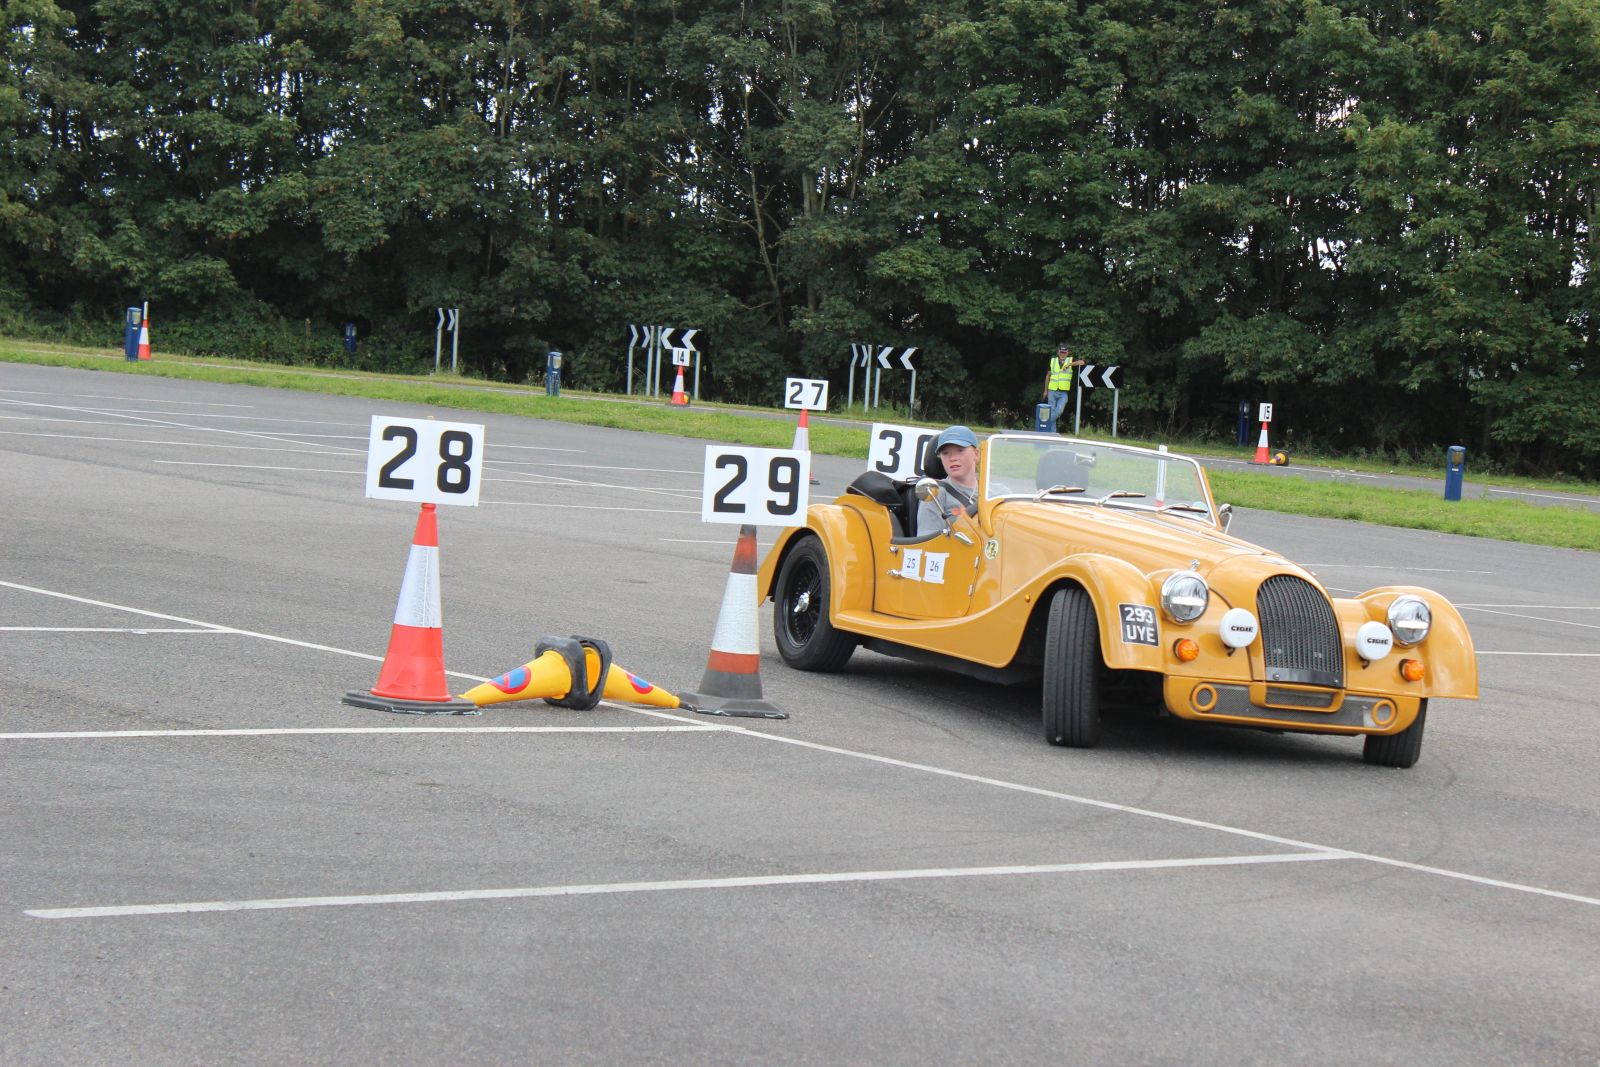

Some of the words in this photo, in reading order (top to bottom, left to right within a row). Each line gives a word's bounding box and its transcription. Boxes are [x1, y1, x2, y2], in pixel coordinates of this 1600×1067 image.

[789, 382, 825, 406] 27
[379, 425, 473, 494] 28
[713, 454, 801, 516] 29
[906, 558, 916, 569] 25
[930, 560, 939, 573] 26
[1124, 607, 1153, 624] 293
[1126, 624, 1156, 643] UYE
